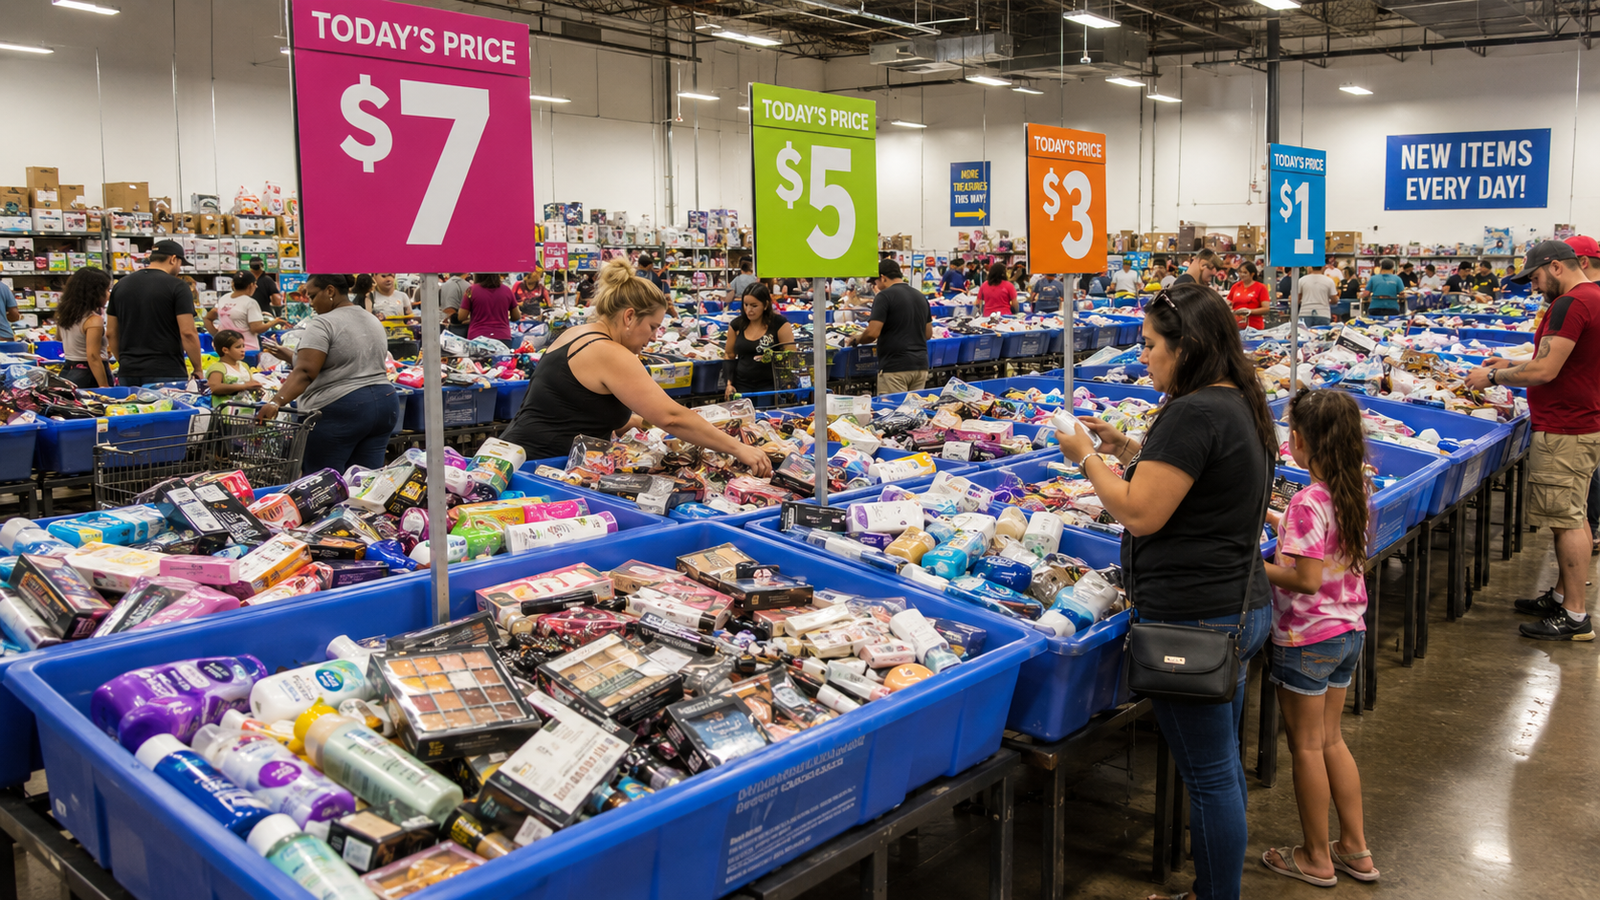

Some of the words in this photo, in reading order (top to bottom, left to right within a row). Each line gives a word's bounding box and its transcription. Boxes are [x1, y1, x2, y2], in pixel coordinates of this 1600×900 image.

[311, 10, 436, 54] TODAY'S
[443, 30, 516, 65] PRICE
[761, 98, 827, 126] TODAY'S
[830, 108, 869, 131] PRICE
[339, 73, 490, 246] $7
[1033, 135, 1075, 155] TODAY'S
[1076, 141, 1102, 158] PRICE
[1274, 153, 1305, 169] TODAY'S
[1304, 157, 1324, 172] PRICE
[1401, 142, 1452, 170] NEW
[1460, 139, 1533, 168] ITEMS
[775, 140, 856, 260] $5
[954, 194, 969, 204] THIS
[1406, 175, 1472, 201] EVERY
[1478, 174, 1526, 199] DAY!
[1042, 167, 1094, 260] $3
[1279, 178, 1314, 255] $1
